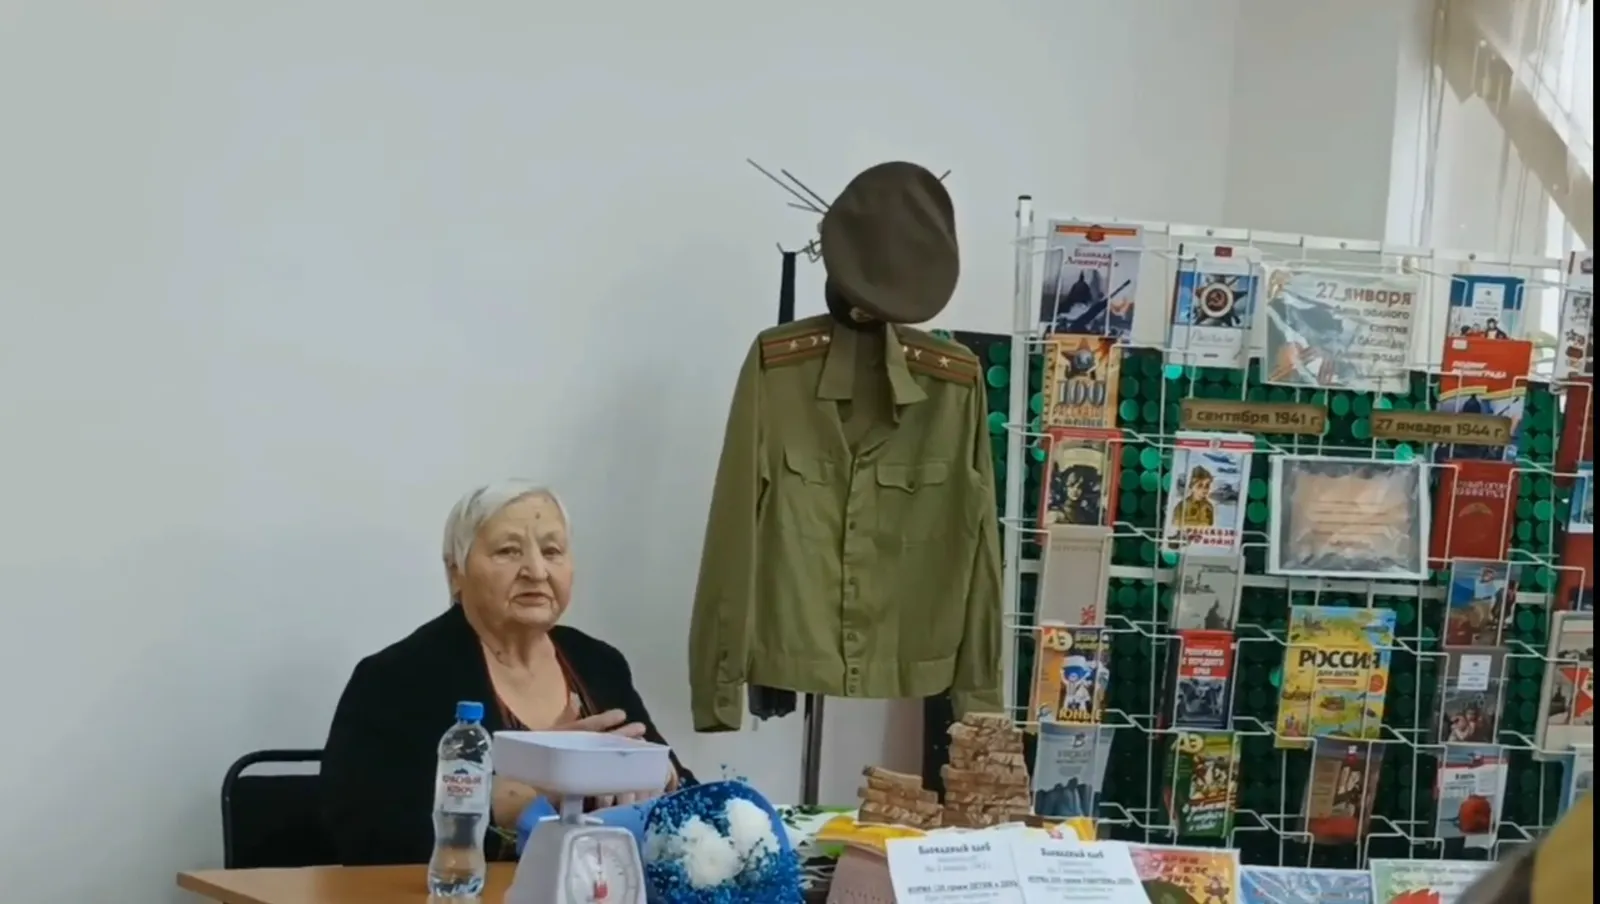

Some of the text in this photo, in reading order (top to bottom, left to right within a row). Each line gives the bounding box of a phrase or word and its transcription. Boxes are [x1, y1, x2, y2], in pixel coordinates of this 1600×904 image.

[1316, 282, 1411, 307] 27 января
[1057, 380, 1106, 405] 100
[1196, 410, 1270, 425] сентября
[1274, 411, 1305, 425] 1941
[1375, 419, 1394, 430] 27
[1396, 423, 1451, 437] января
[1457, 424, 1488, 435] 1944
[1298, 650, 1381, 669] РОССИЯ
